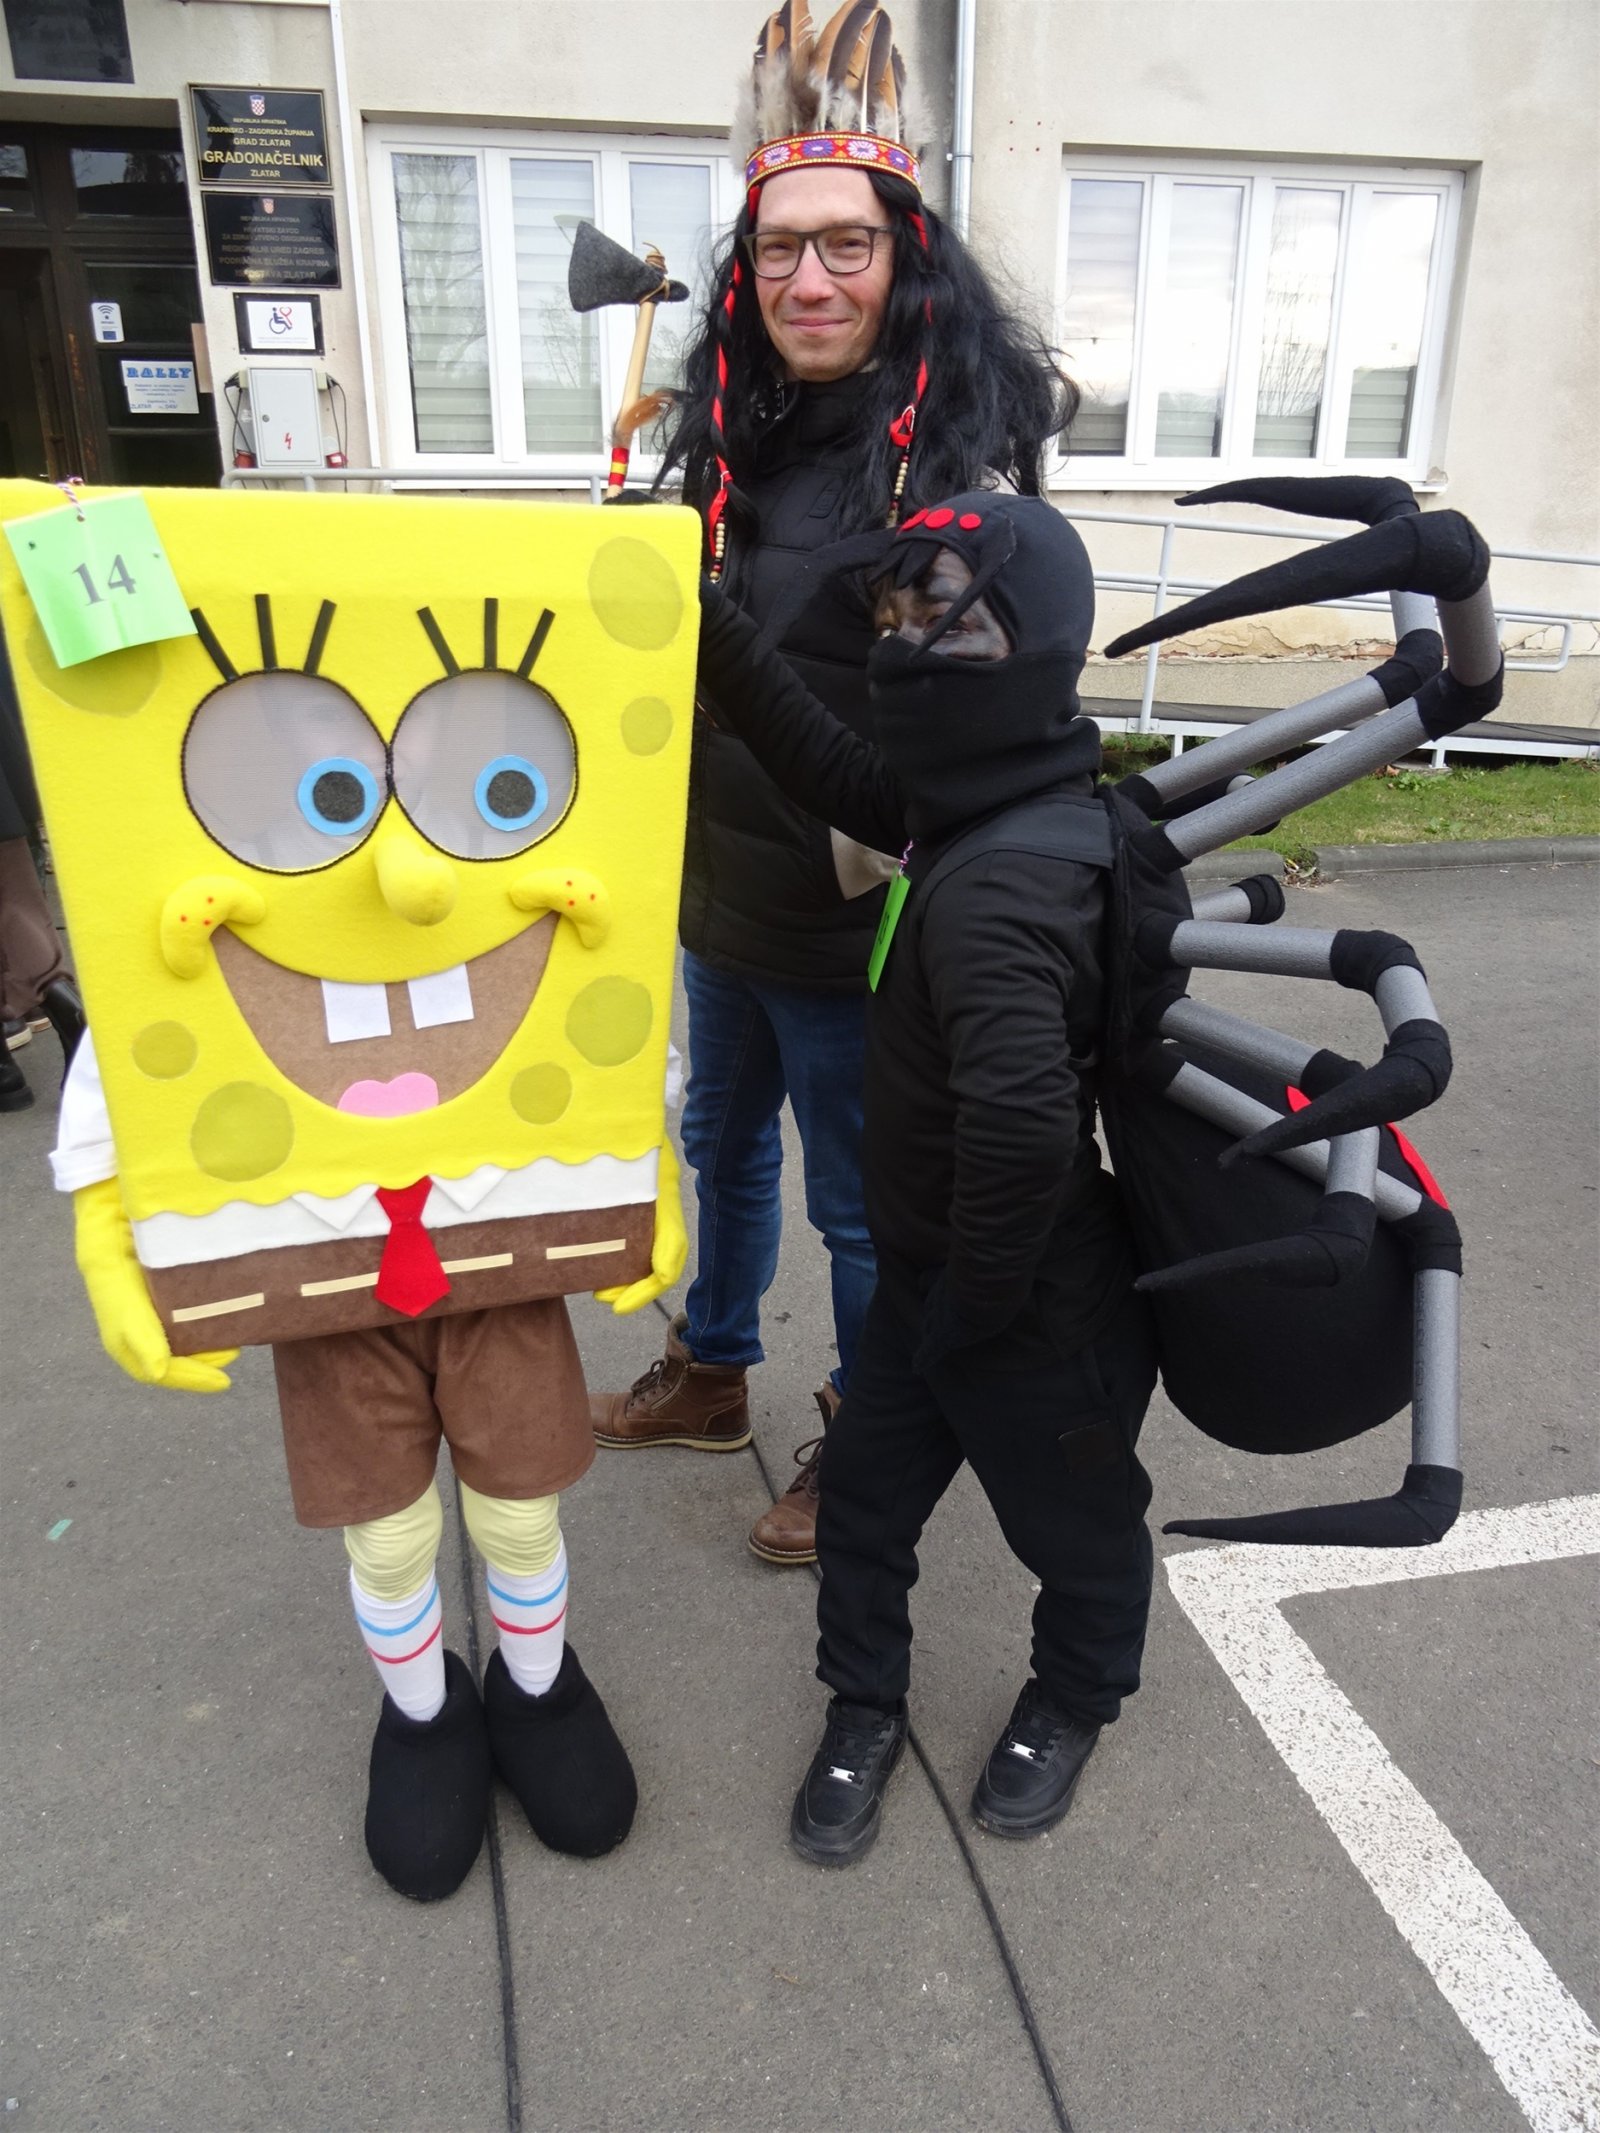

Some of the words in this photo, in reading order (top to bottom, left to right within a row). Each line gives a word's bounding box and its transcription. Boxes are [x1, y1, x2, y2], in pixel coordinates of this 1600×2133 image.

[207, 126, 244, 134] KRAPINSKO
[248, 127, 283, 136] ZAGORSKA
[284, 128, 315, 137] ŽUPANIJA
[233, 137, 258, 146] GRAD
[259, 138, 291, 147] ZLATAR
[203, 150, 324, 167] GRADONAČELNIK
[250, 169, 281, 177] ZLATAR
[126, 367, 192, 379] RALLY
[72, 554, 136, 606] 14
